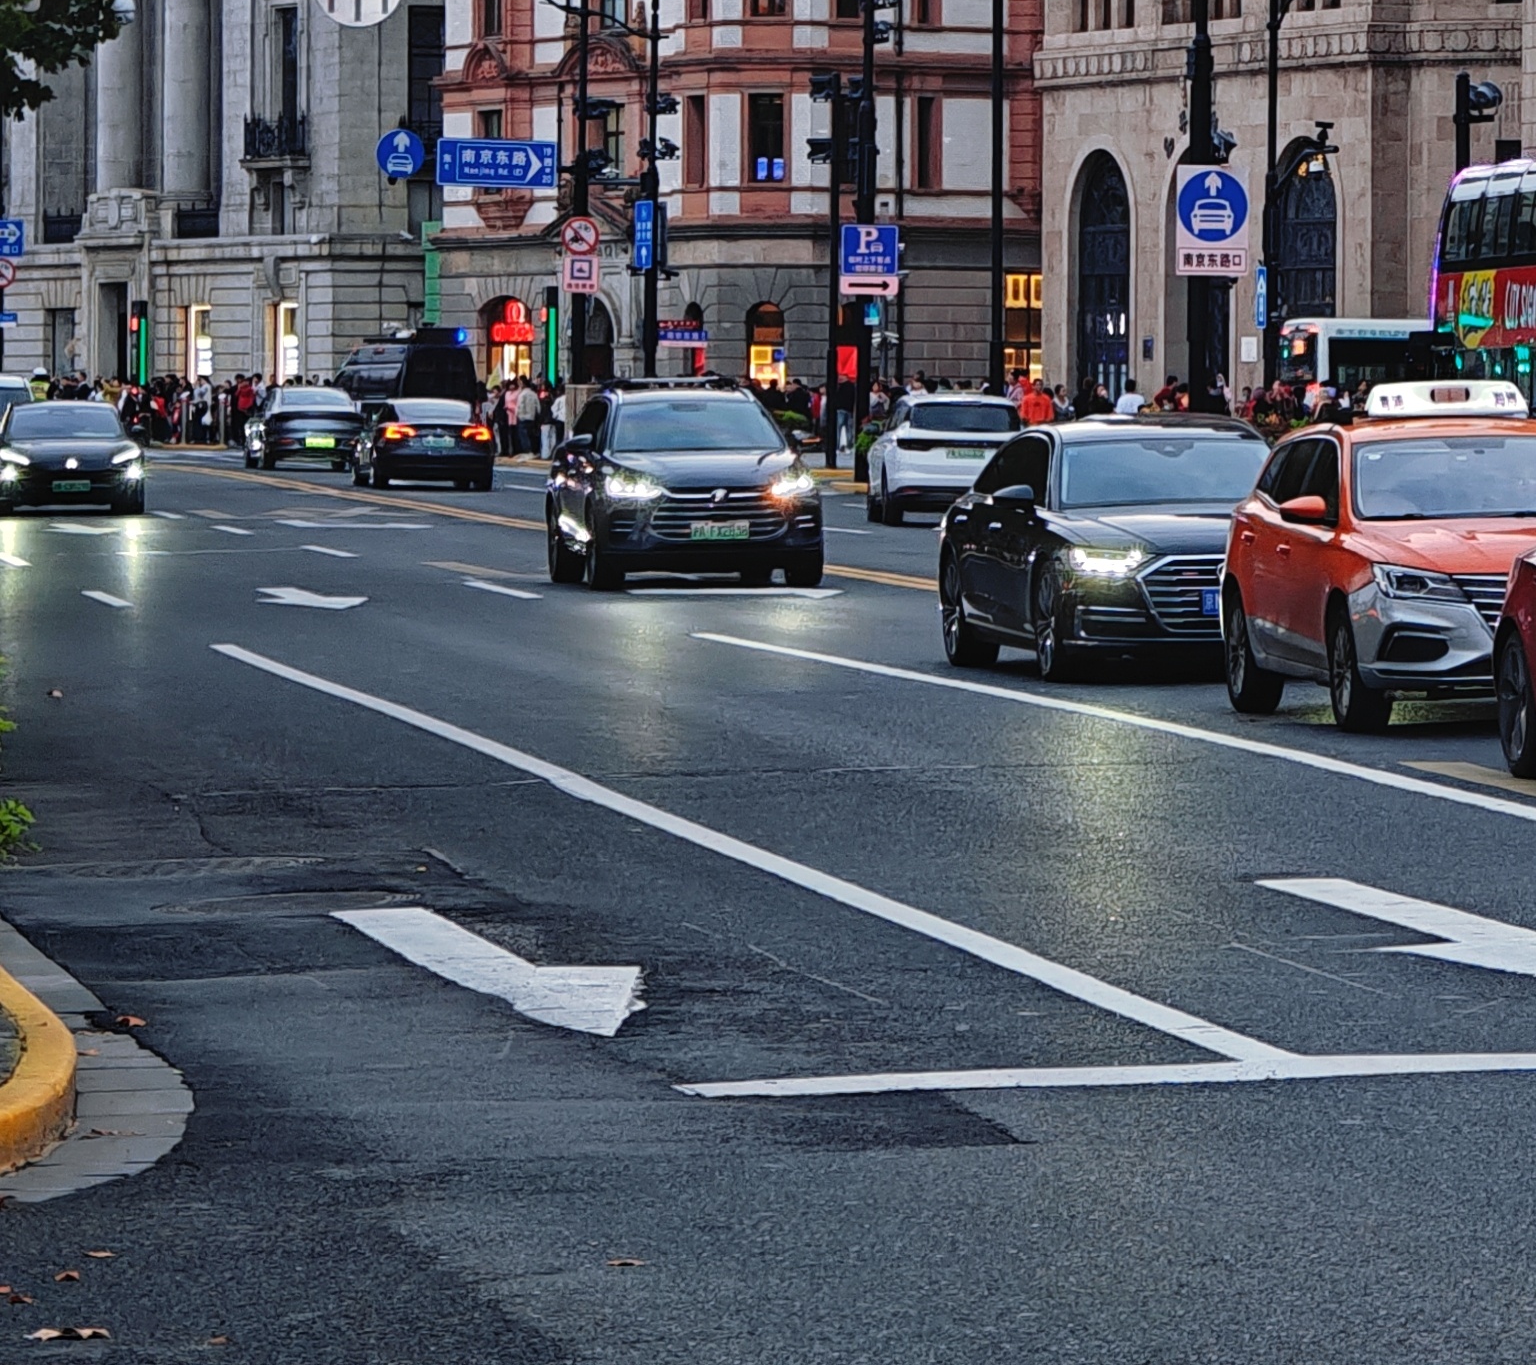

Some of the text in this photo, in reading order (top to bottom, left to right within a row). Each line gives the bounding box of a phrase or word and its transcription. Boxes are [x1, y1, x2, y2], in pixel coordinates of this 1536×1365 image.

[461, 148, 527, 166] 南京东路
[856, 227, 879, 254] P
[1182, 252, 1242, 268] 南京东路口
